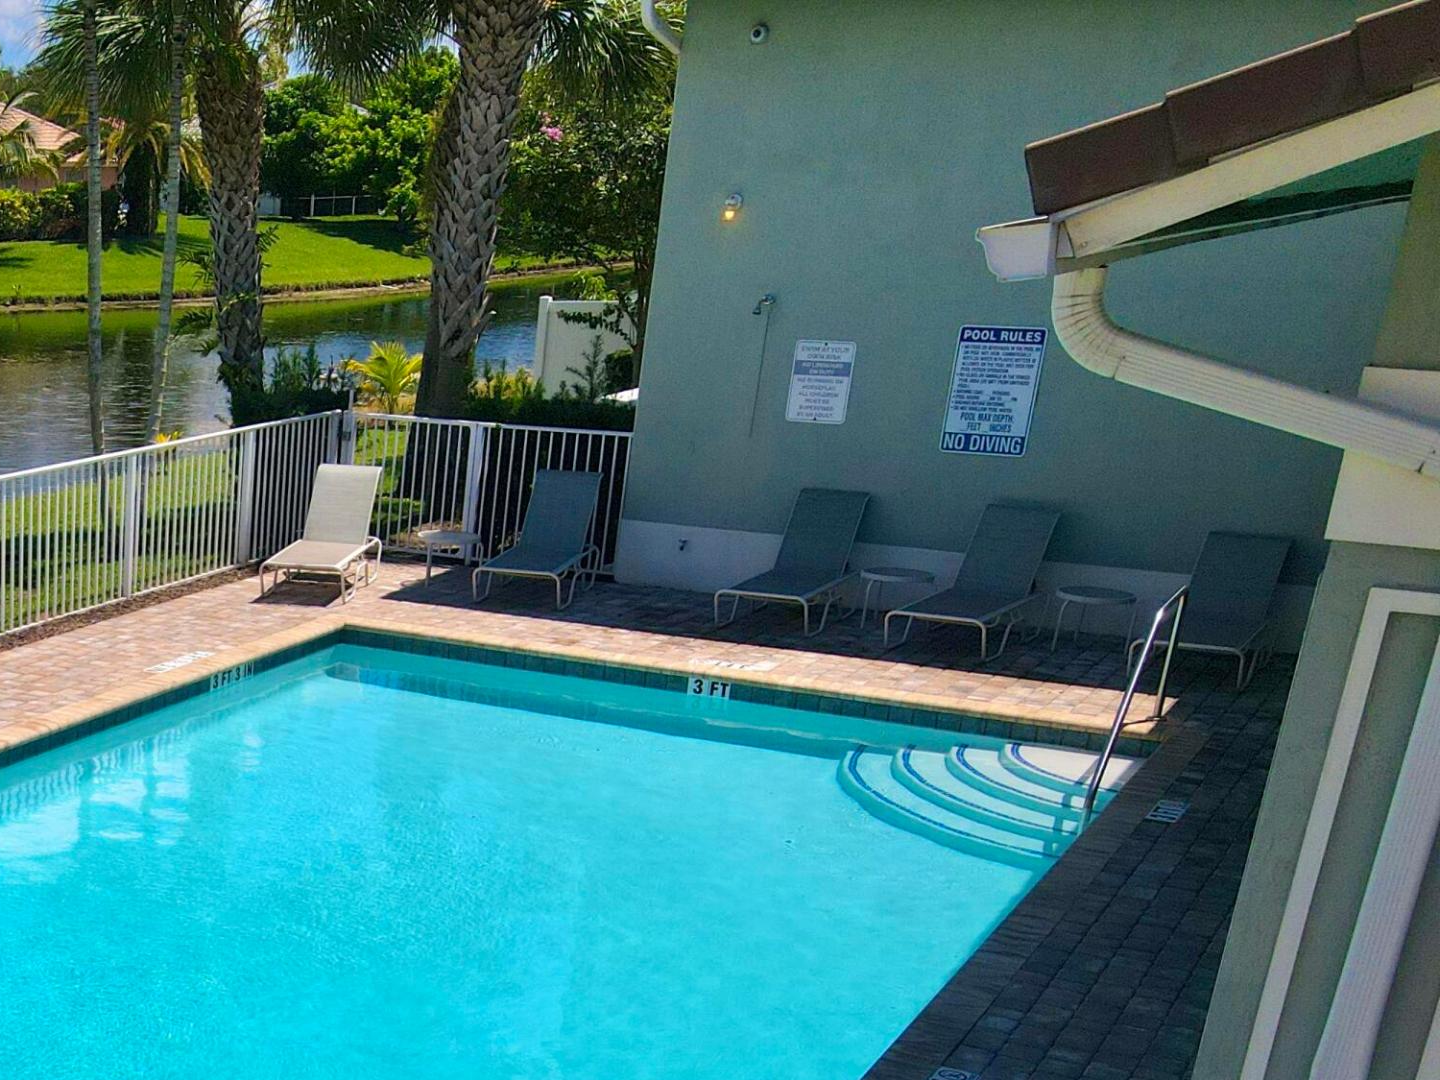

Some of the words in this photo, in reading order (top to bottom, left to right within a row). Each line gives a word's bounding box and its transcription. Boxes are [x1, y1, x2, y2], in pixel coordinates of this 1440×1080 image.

[963, 329, 997, 341] POOL
[1000, 331, 1042, 342] RULES
[943, 433, 965, 449] NO
[969, 434, 1022, 454] DIVING
[221, 670, 233, 686] FT
[693, 679, 703, 694] 3
[709, 681, 729, 697] FT
